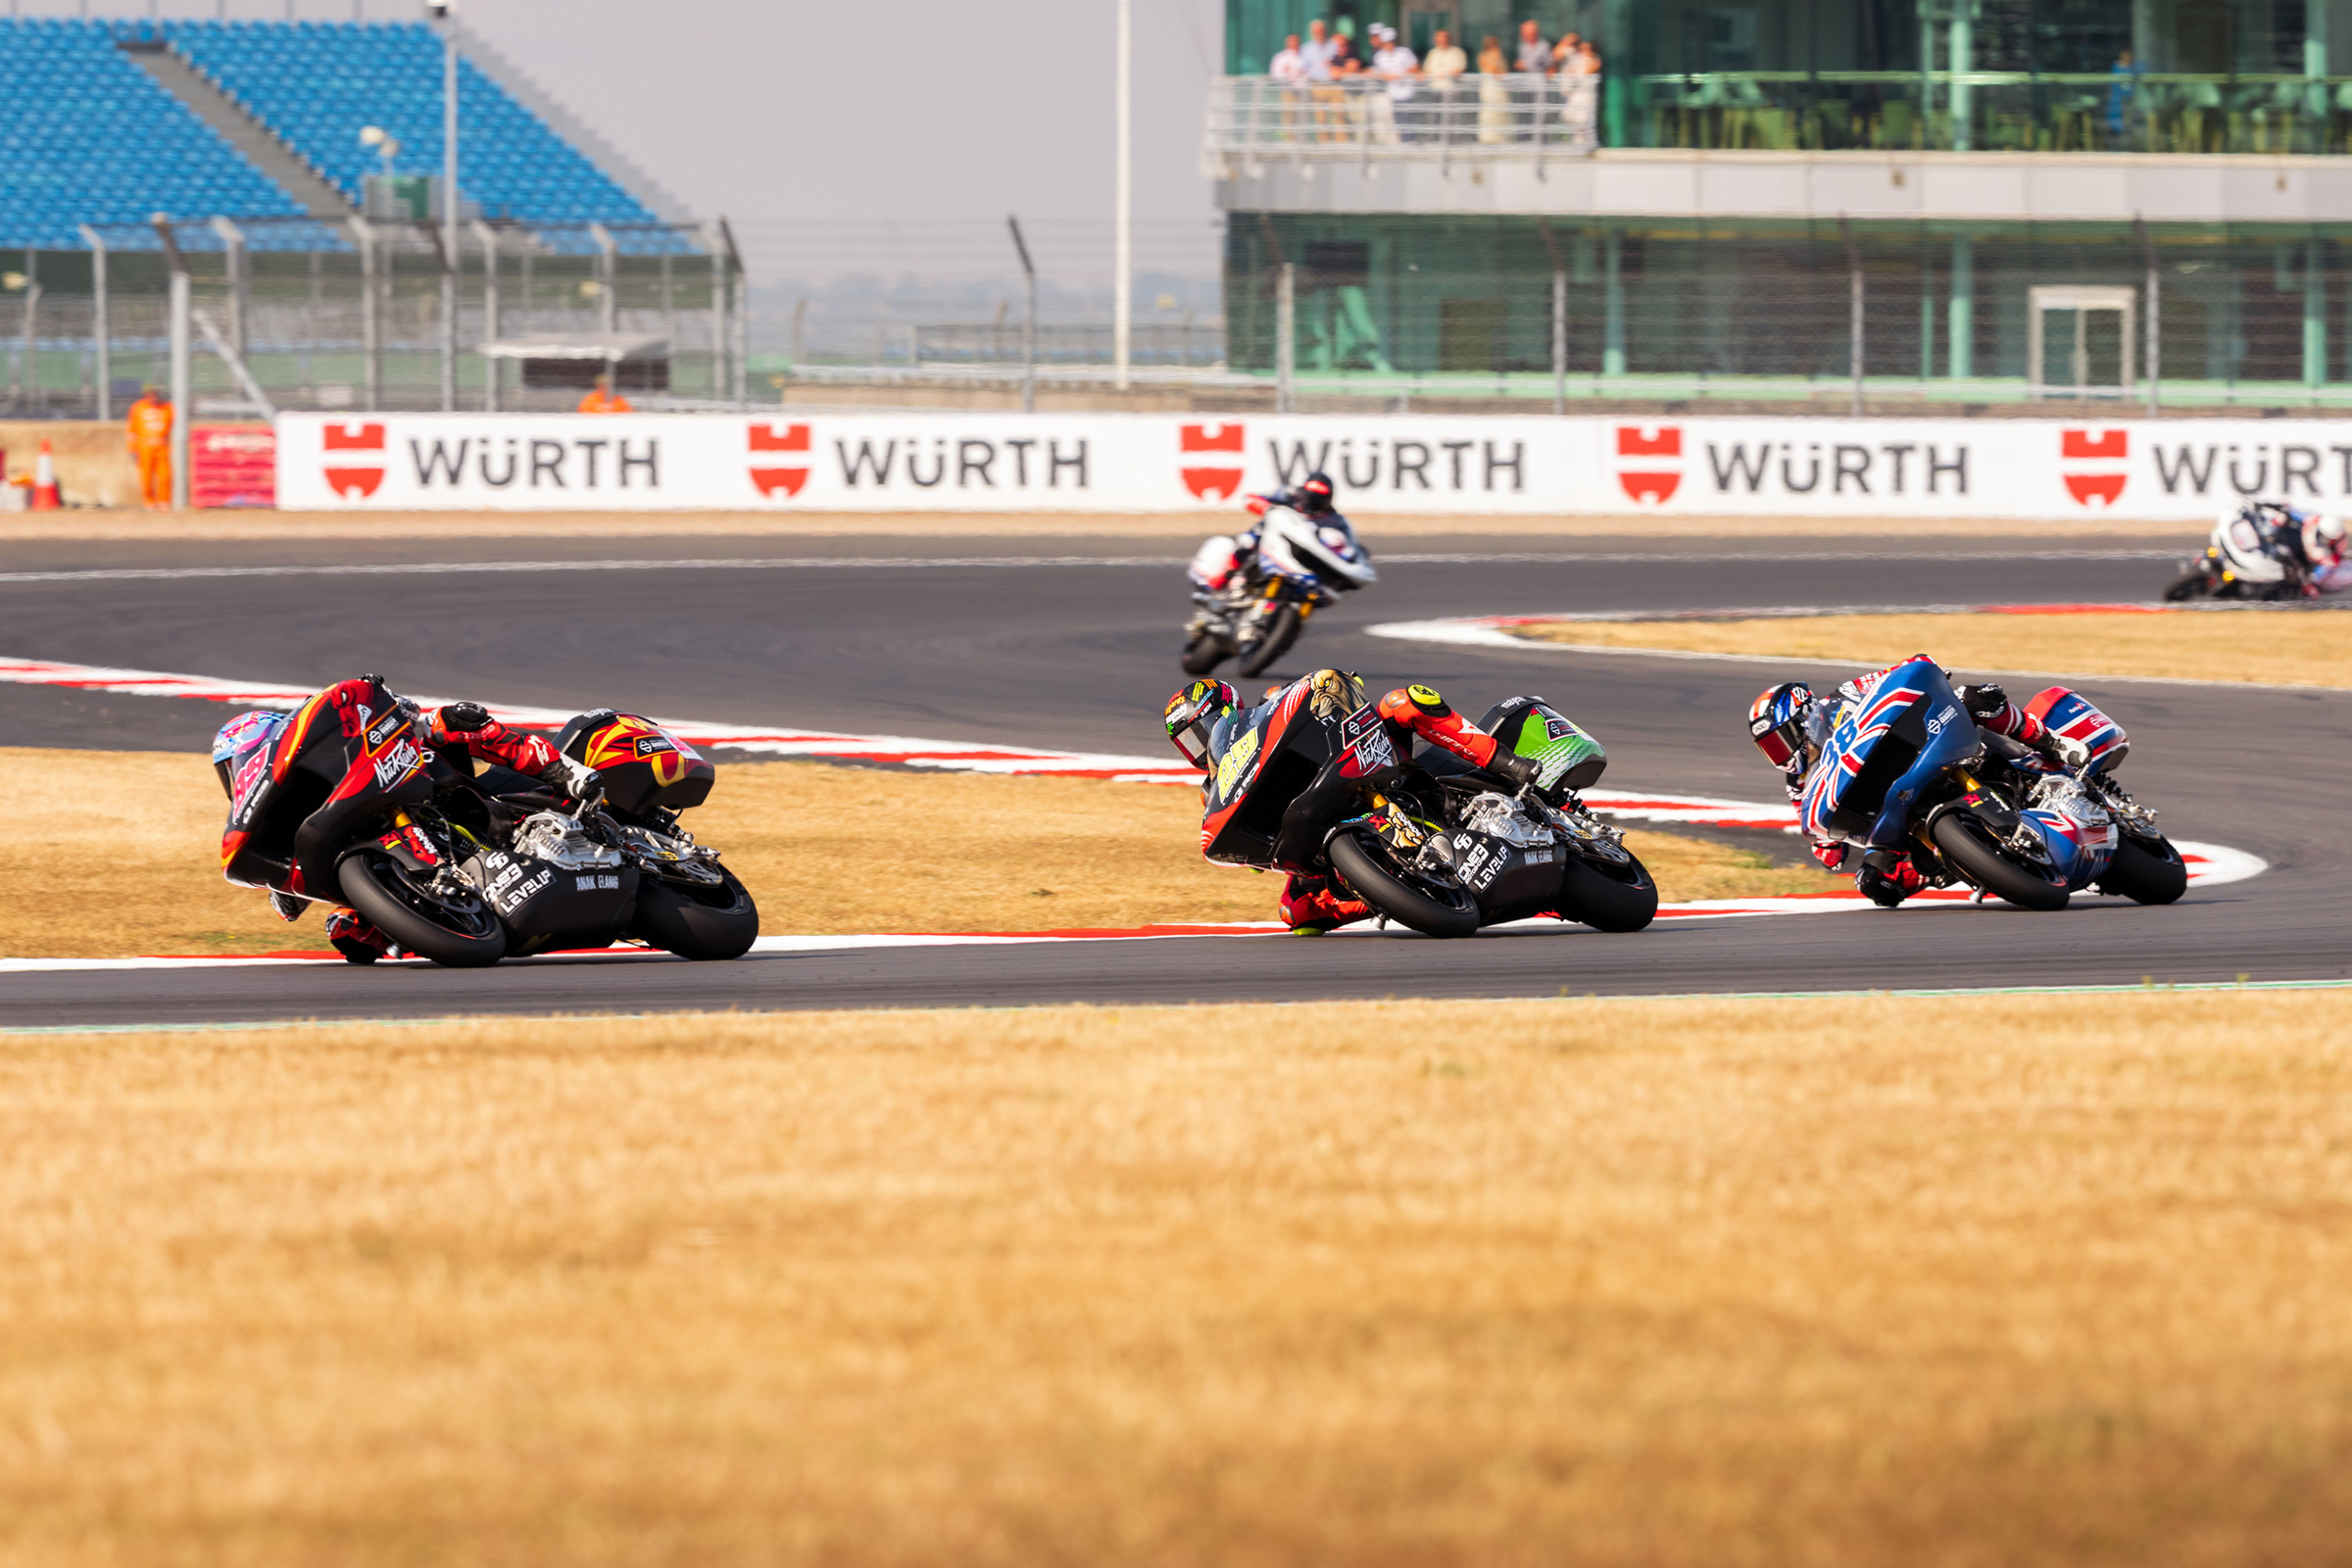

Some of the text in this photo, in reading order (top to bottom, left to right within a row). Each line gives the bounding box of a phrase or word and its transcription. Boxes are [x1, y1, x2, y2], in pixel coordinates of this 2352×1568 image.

[410, 438, 658, 487] WÜRTH
[836, 438, 1086, 487] WÜRTH
[1269, 439, 1522, 489] WÜRTH
[1707, 443, 1967, 493] WÜRTH
[1217, 726, 1258, 804] 29
[1820, 716, 1858, 779] 38
[232, 742, 270, 823] 99
[575, 874, 619, 891] ANAK ELANG
